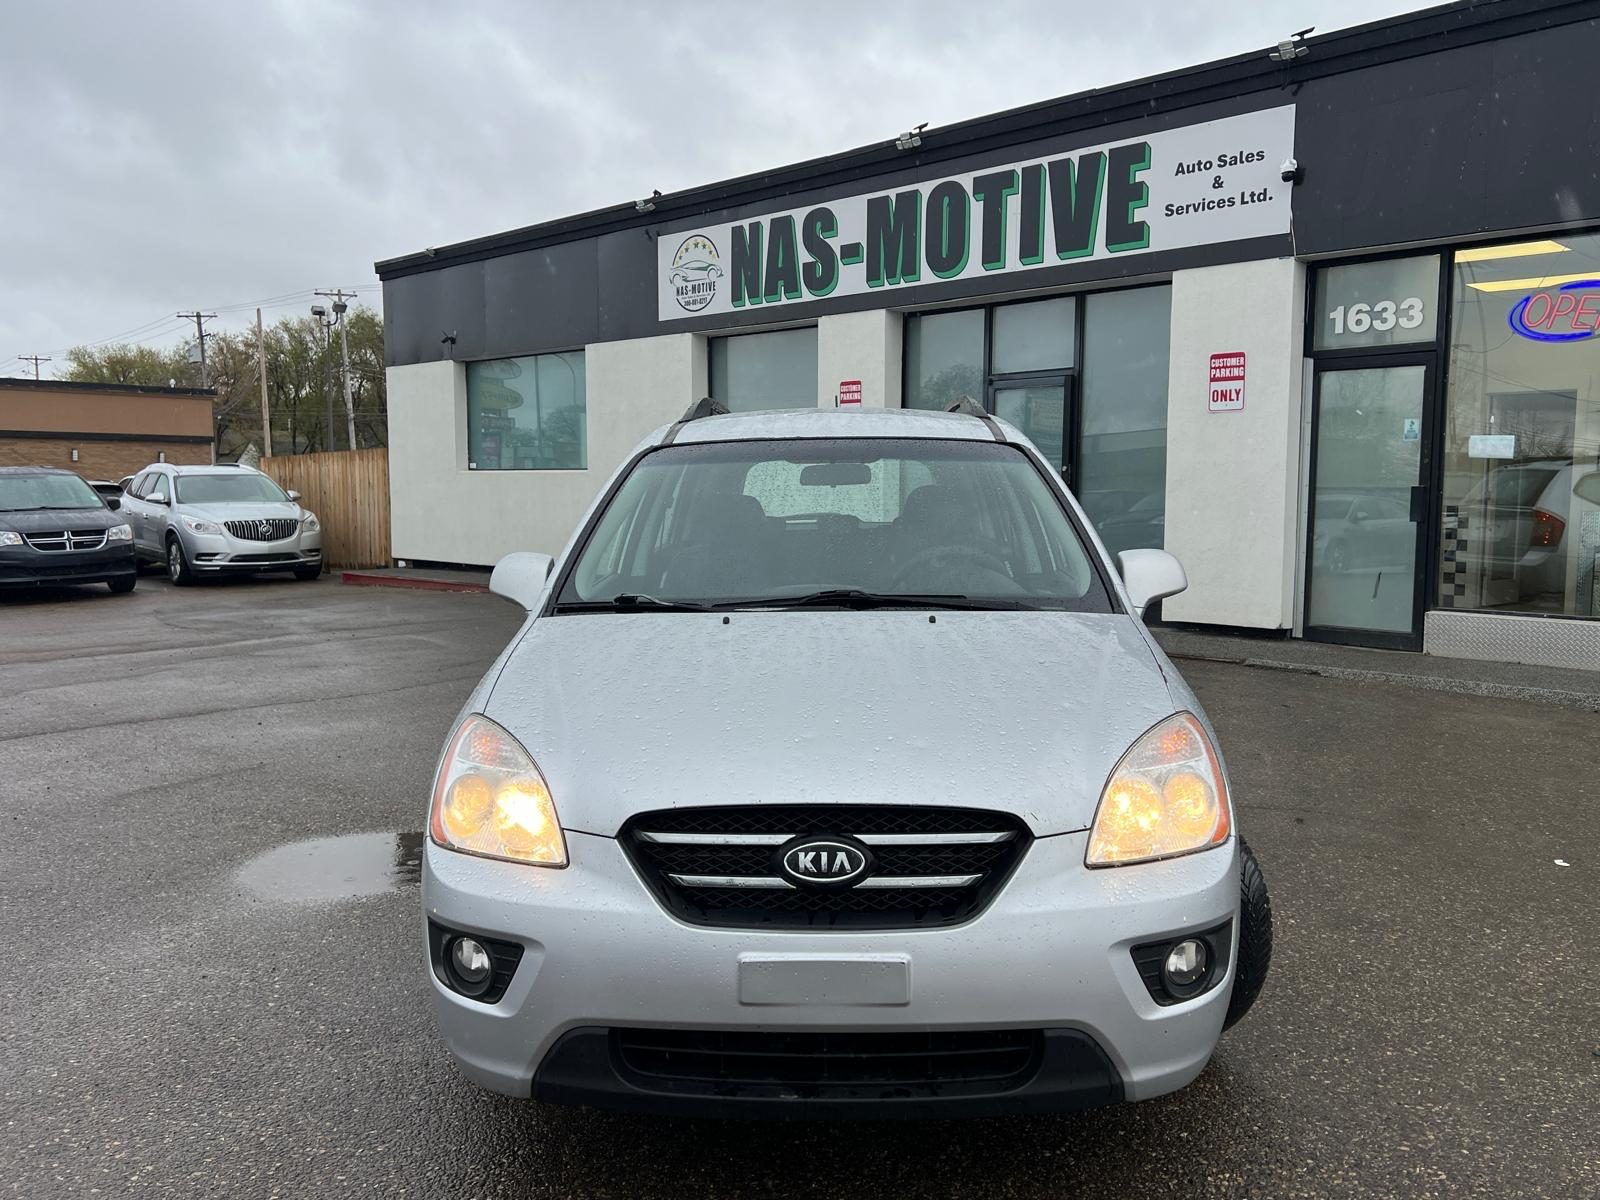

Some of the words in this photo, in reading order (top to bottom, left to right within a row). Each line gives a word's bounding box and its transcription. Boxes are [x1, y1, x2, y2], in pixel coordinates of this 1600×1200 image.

[1174, 159, 1213, 177] Auto
[1217, 150, 1265, 168] Sales
[1212, 175, 1224, 189] &
[1164, 198, 1236, 217] Services
[1240, 187, 1273, 205] Ltd.
[731, 141, 1152, 308] NAS-MOTIVE
[676, 281, 716, 297] NAS-MOTIVE
[1329, 297, 1424, 334] 1633
[1524, 293, 1600, 329] OPE
[1211, 356, 1245, 368] CUSTOMER
[1211, 366, 1245, 379] PARKING
[1212, 388, 1241, 403] ONLY
[798, 851, 851, 872] KIA
